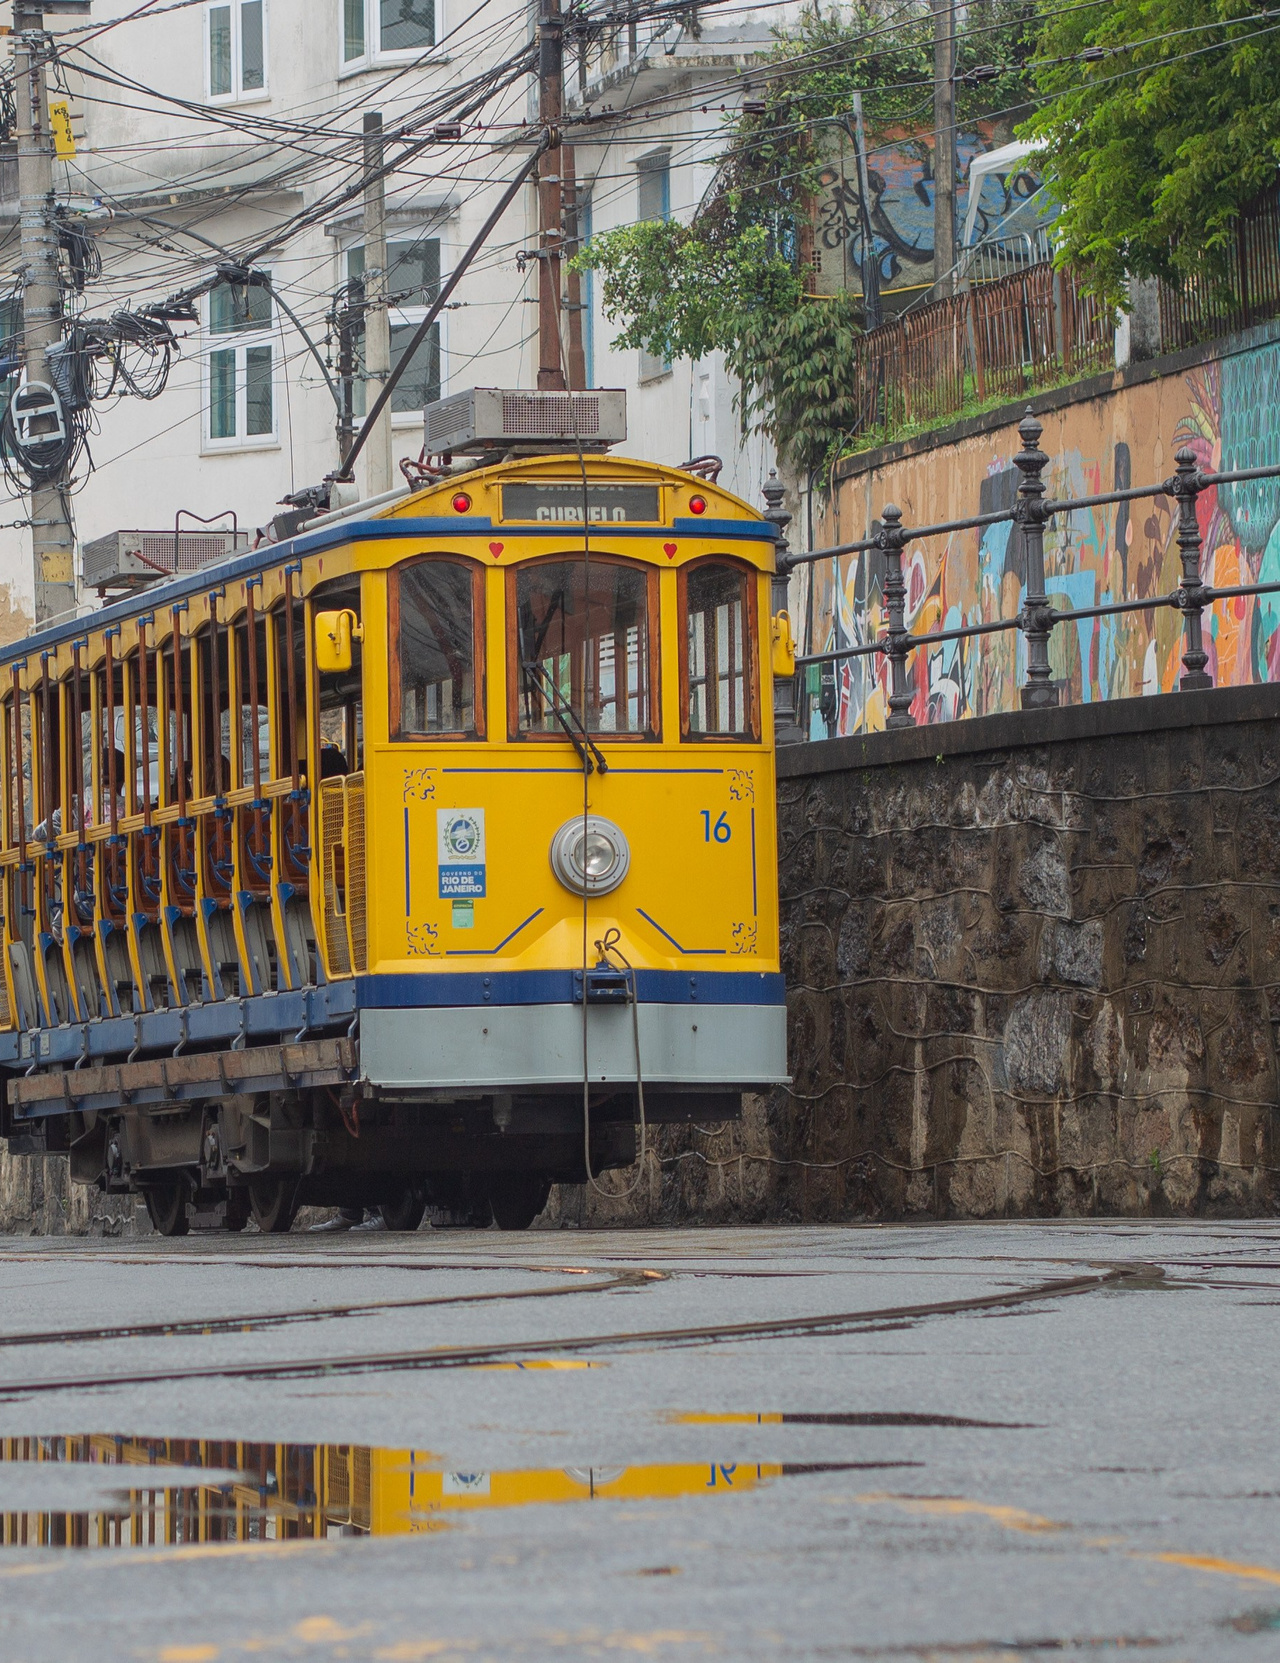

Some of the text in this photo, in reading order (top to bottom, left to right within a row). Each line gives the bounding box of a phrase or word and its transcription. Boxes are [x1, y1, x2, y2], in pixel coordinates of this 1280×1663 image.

[700, 810, 732, 843] 16
[441, 876, 474, 885] RIO DE
[441, 885, 483, 893] JANEIRO
